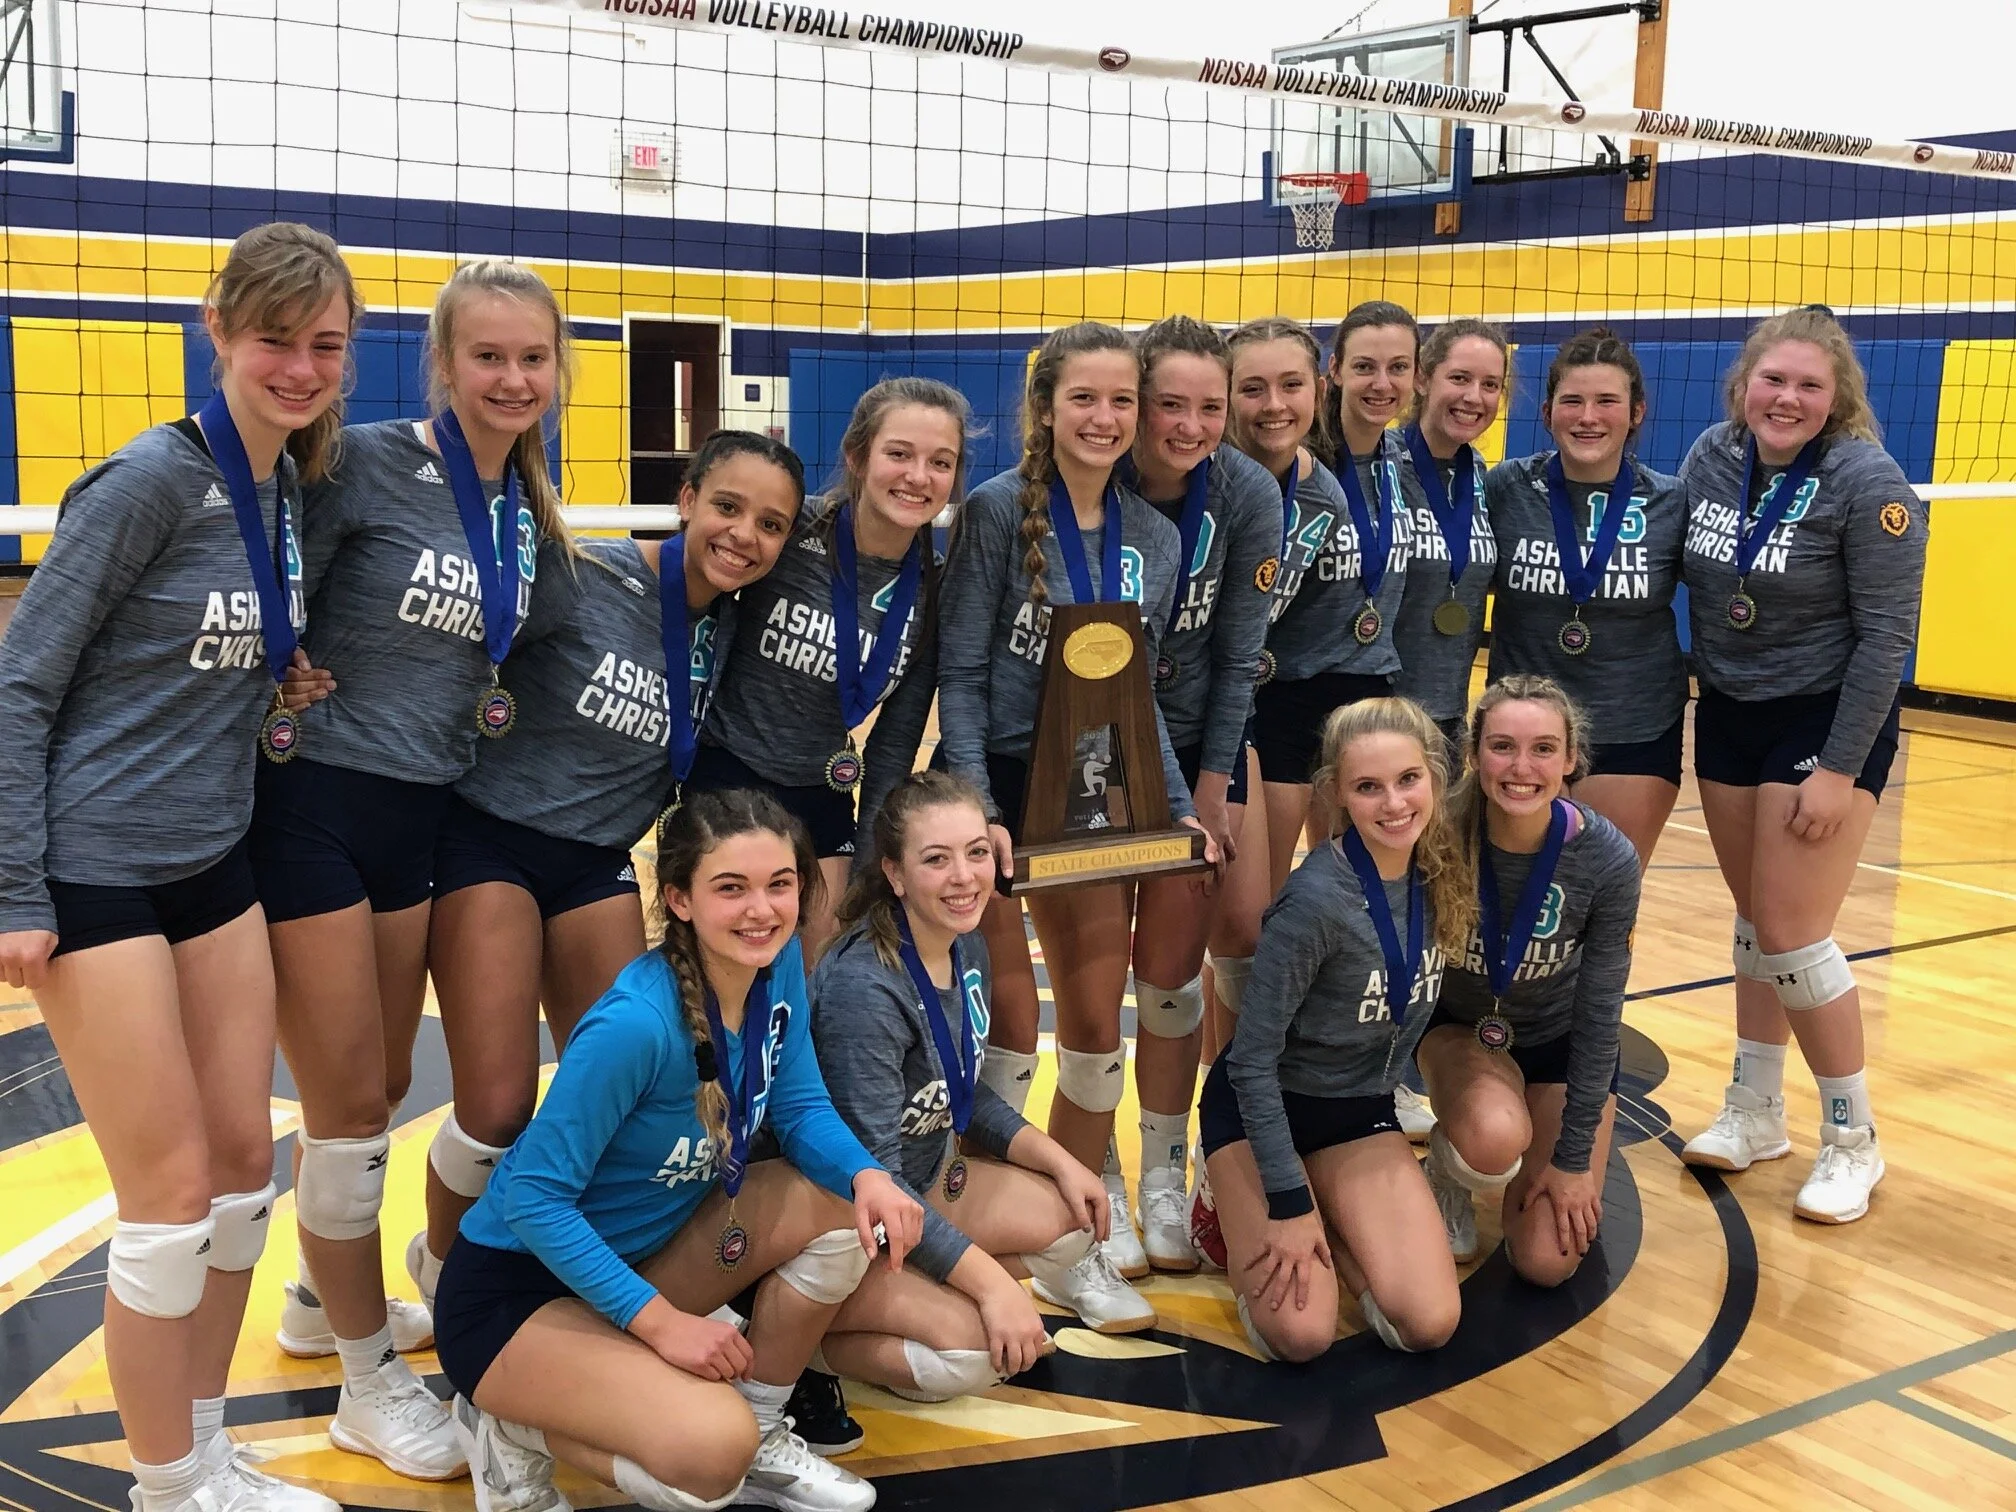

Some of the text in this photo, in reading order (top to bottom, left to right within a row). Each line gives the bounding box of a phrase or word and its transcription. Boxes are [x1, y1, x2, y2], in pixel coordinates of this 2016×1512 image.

[708, 0, 850, 39] VOLLEYBALL
[858, 14, 1023, 59] CHAMPIONSHIP
[1198, 57, 1506, 115] NCISAA VOLLEYBALL CHAMPIONSHIP
[634, 145, 657, 167] EXIT
[1635, 110, 1873, 157] NCISAA VOLLEYBALL CHAMPIONSHIP
[1972, 150, 2015, 174] NCISAA
[1586, 491, 1648, 543] 15
[1038, 844, 1183, 875] STATE CHAMPIONS
